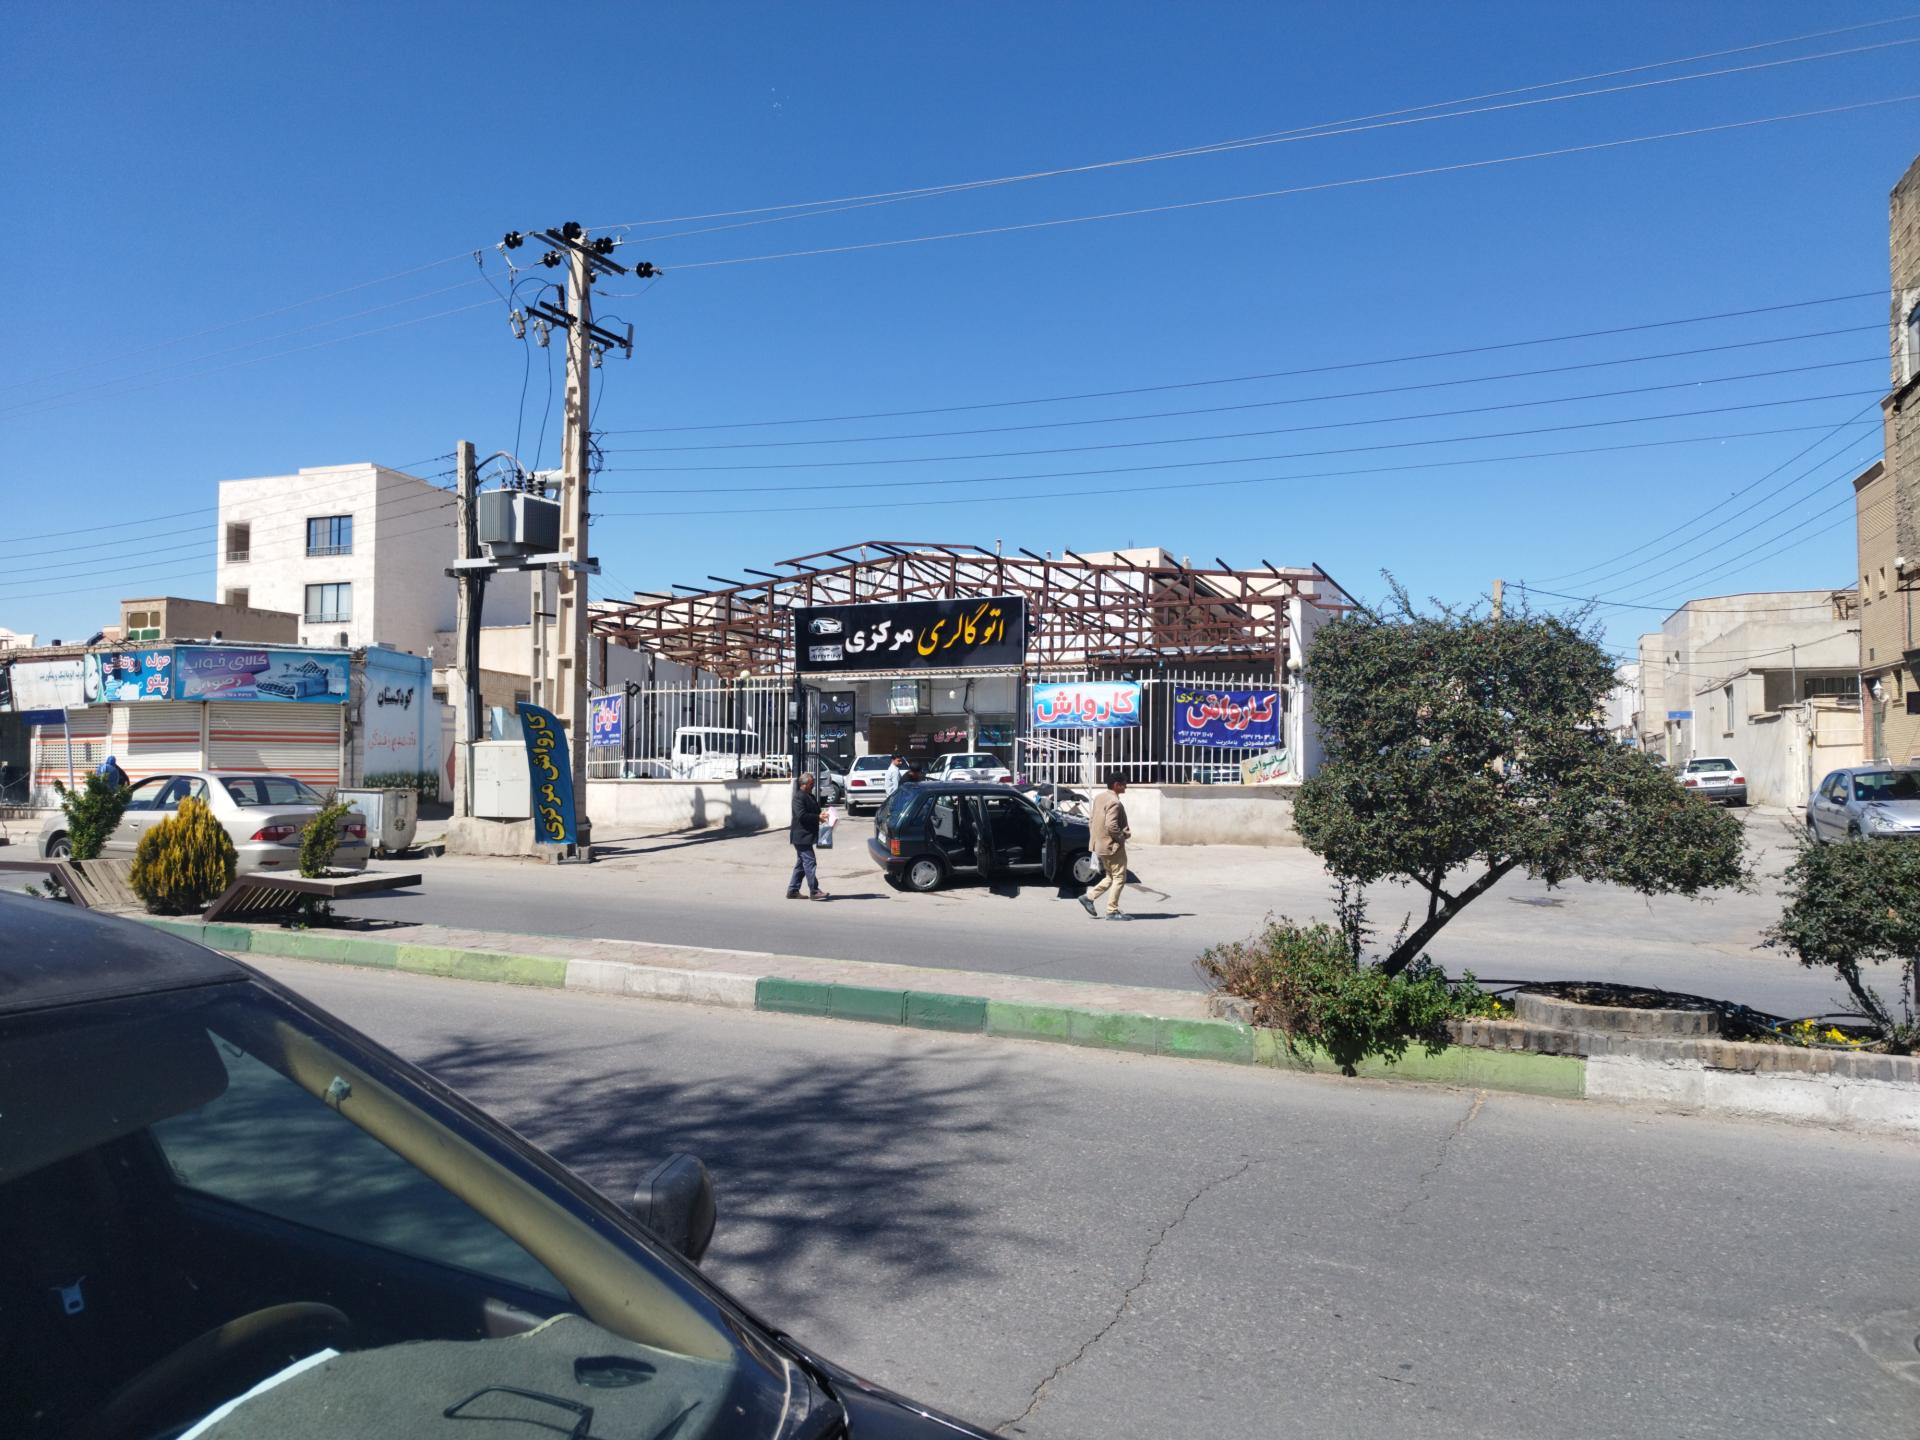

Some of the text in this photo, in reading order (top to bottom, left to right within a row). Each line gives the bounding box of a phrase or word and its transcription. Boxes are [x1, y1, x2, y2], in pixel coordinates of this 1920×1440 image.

[845, 620, 914, 653] مرکزی
[917, 602, 989, 656] گالری
[146, 652, 170, 671] حوله
[228, 655, 268, 671] کالای
[146, 674, 169, 695] پتو
[1176, 692, 1205, 704] مرکزی
[377, 687, 414, 711] کودکستان
[1037, 691, 1135, 722] کارواش
[1187, 694, 1277, 730] کارواش
[526, 713, 566, 841] کارواش مرکزی
